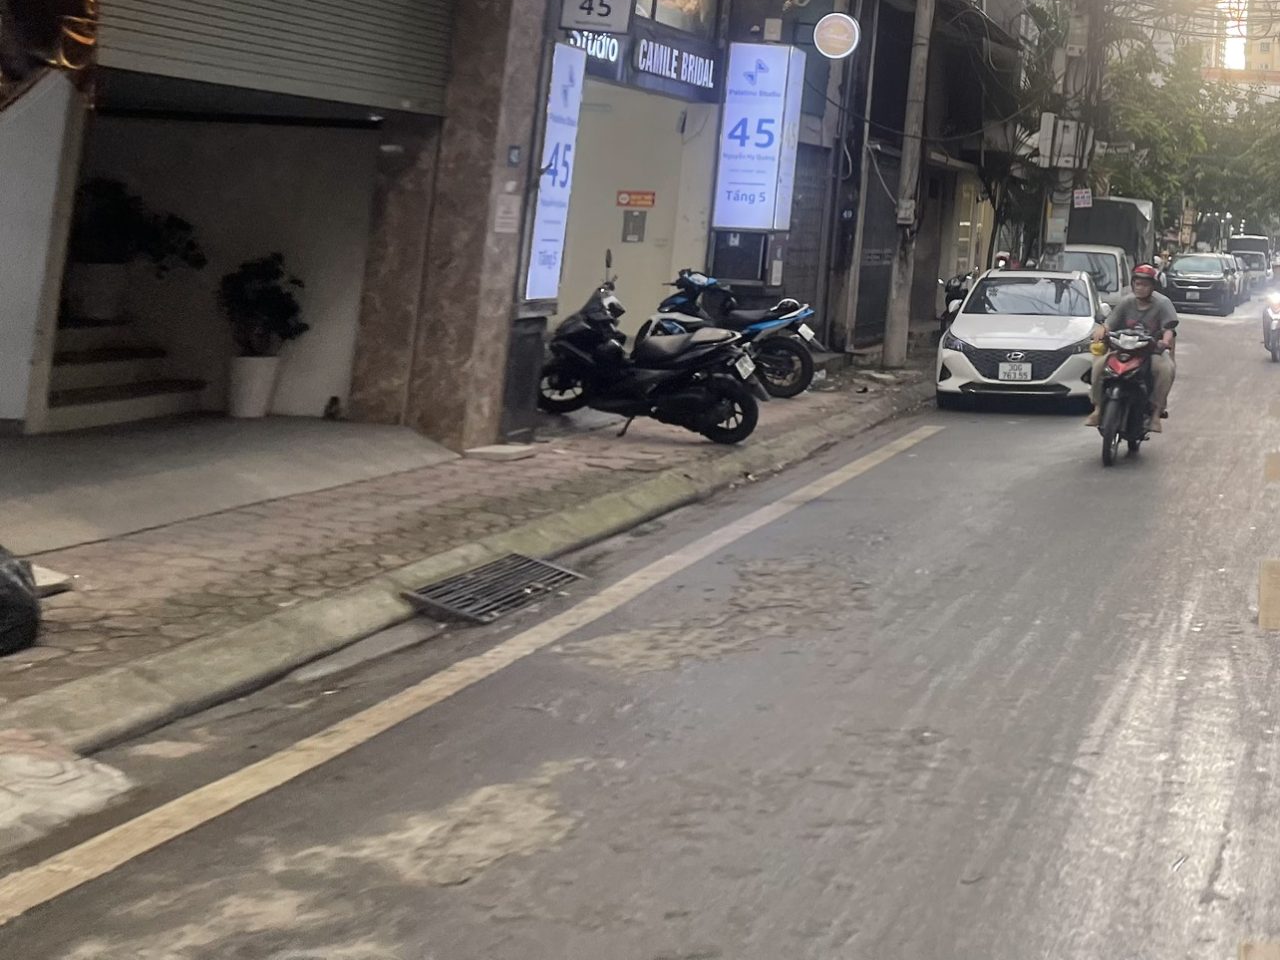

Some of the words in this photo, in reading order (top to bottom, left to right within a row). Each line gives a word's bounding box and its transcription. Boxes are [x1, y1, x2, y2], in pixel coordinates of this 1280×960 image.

[639, 39, 678, 80] CAMILE
[680, 51, 714, 88] BRIDAL
[727, 117, 776, 149] 45
[547, 142, 572, 188] 45
[759, 192, 766, 203] 5
